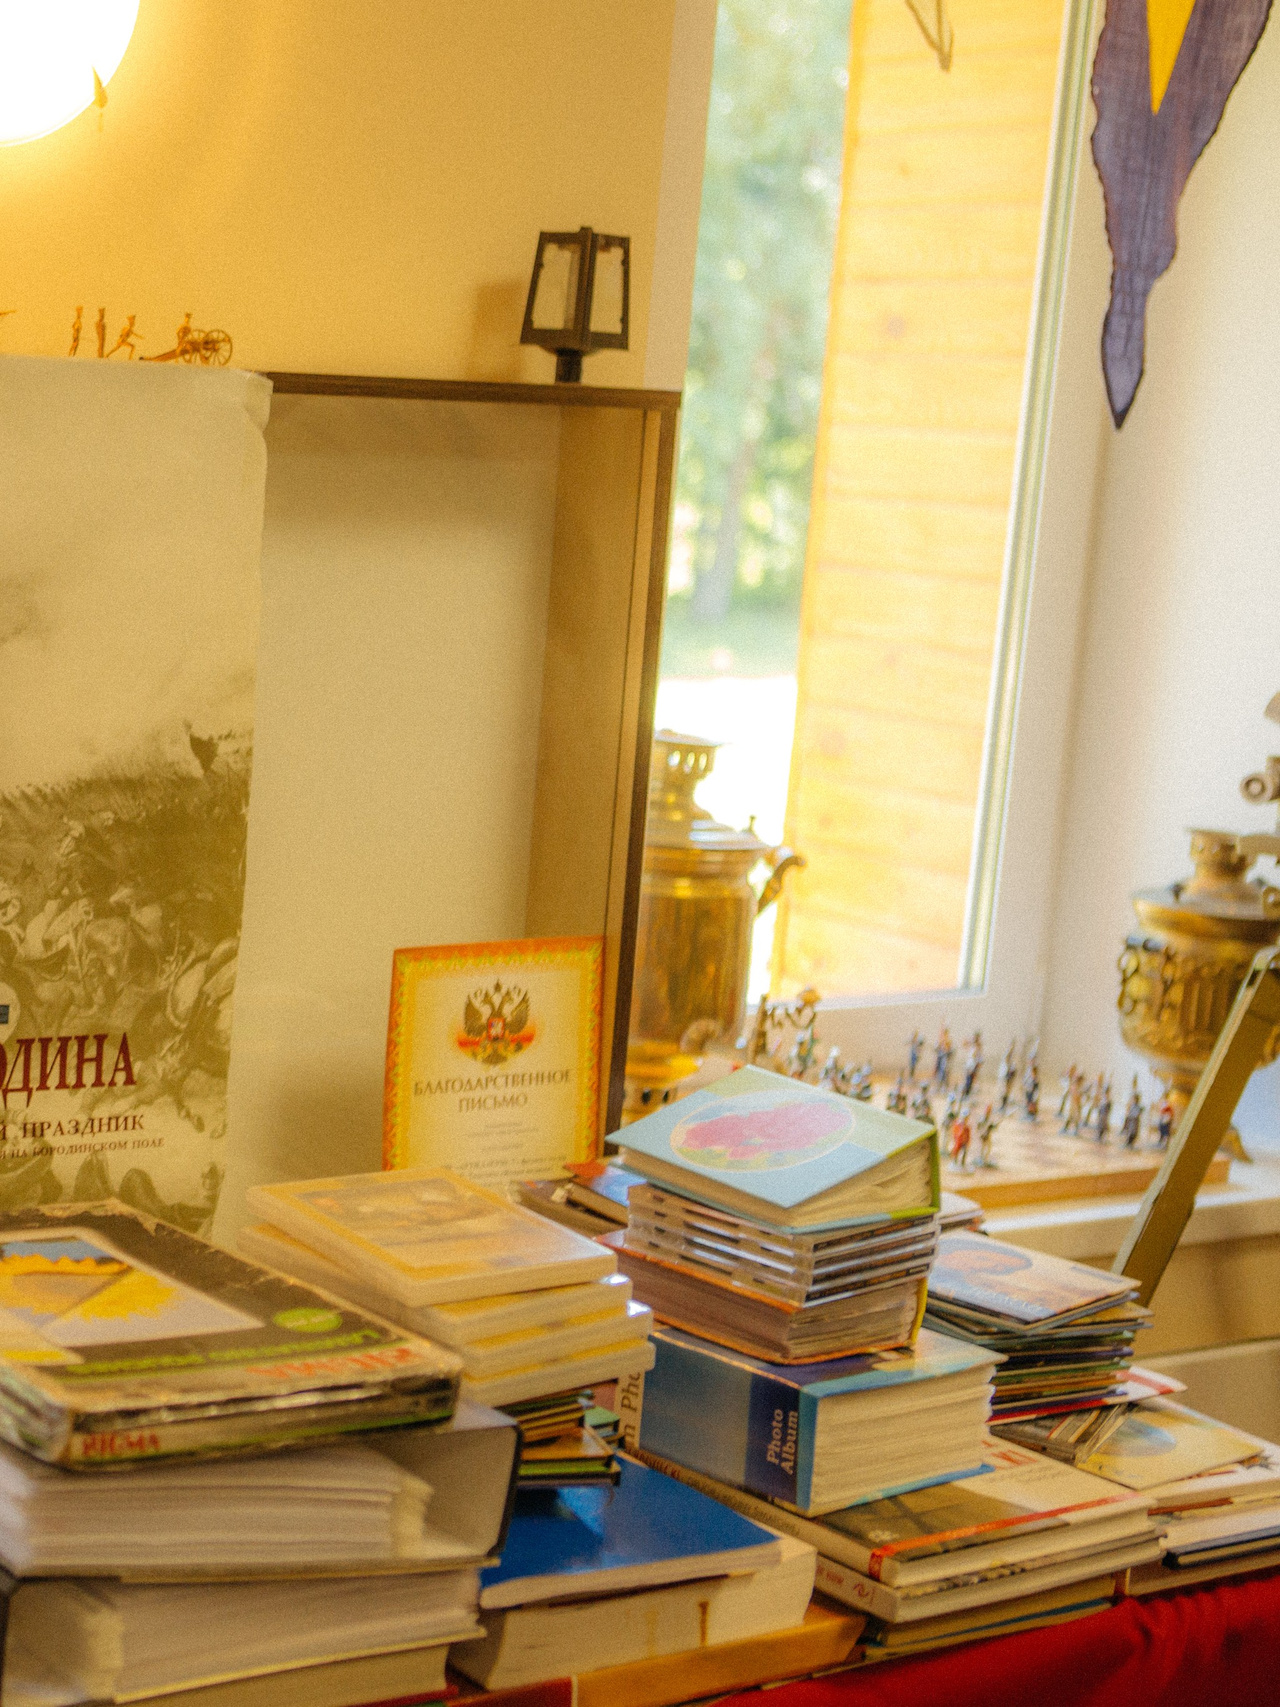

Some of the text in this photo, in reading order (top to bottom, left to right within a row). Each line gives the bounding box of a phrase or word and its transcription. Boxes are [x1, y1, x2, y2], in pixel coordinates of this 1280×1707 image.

[413, 1069, 572, 1097] БЛАГОДАРСТВЕННОЕ
[458, 1093, 528, 1113] ПИСЬМО
[22, 1114, 144, 1138] ПРАЗДНИК
[32, 1141, 128, 1157] БОРОДИНСКОМ
[132, 1137, 165, 1149] ПОЛЕ
[766, 1408, 783, 1466] Photo
[781, 1410, 798, 1475] Album
